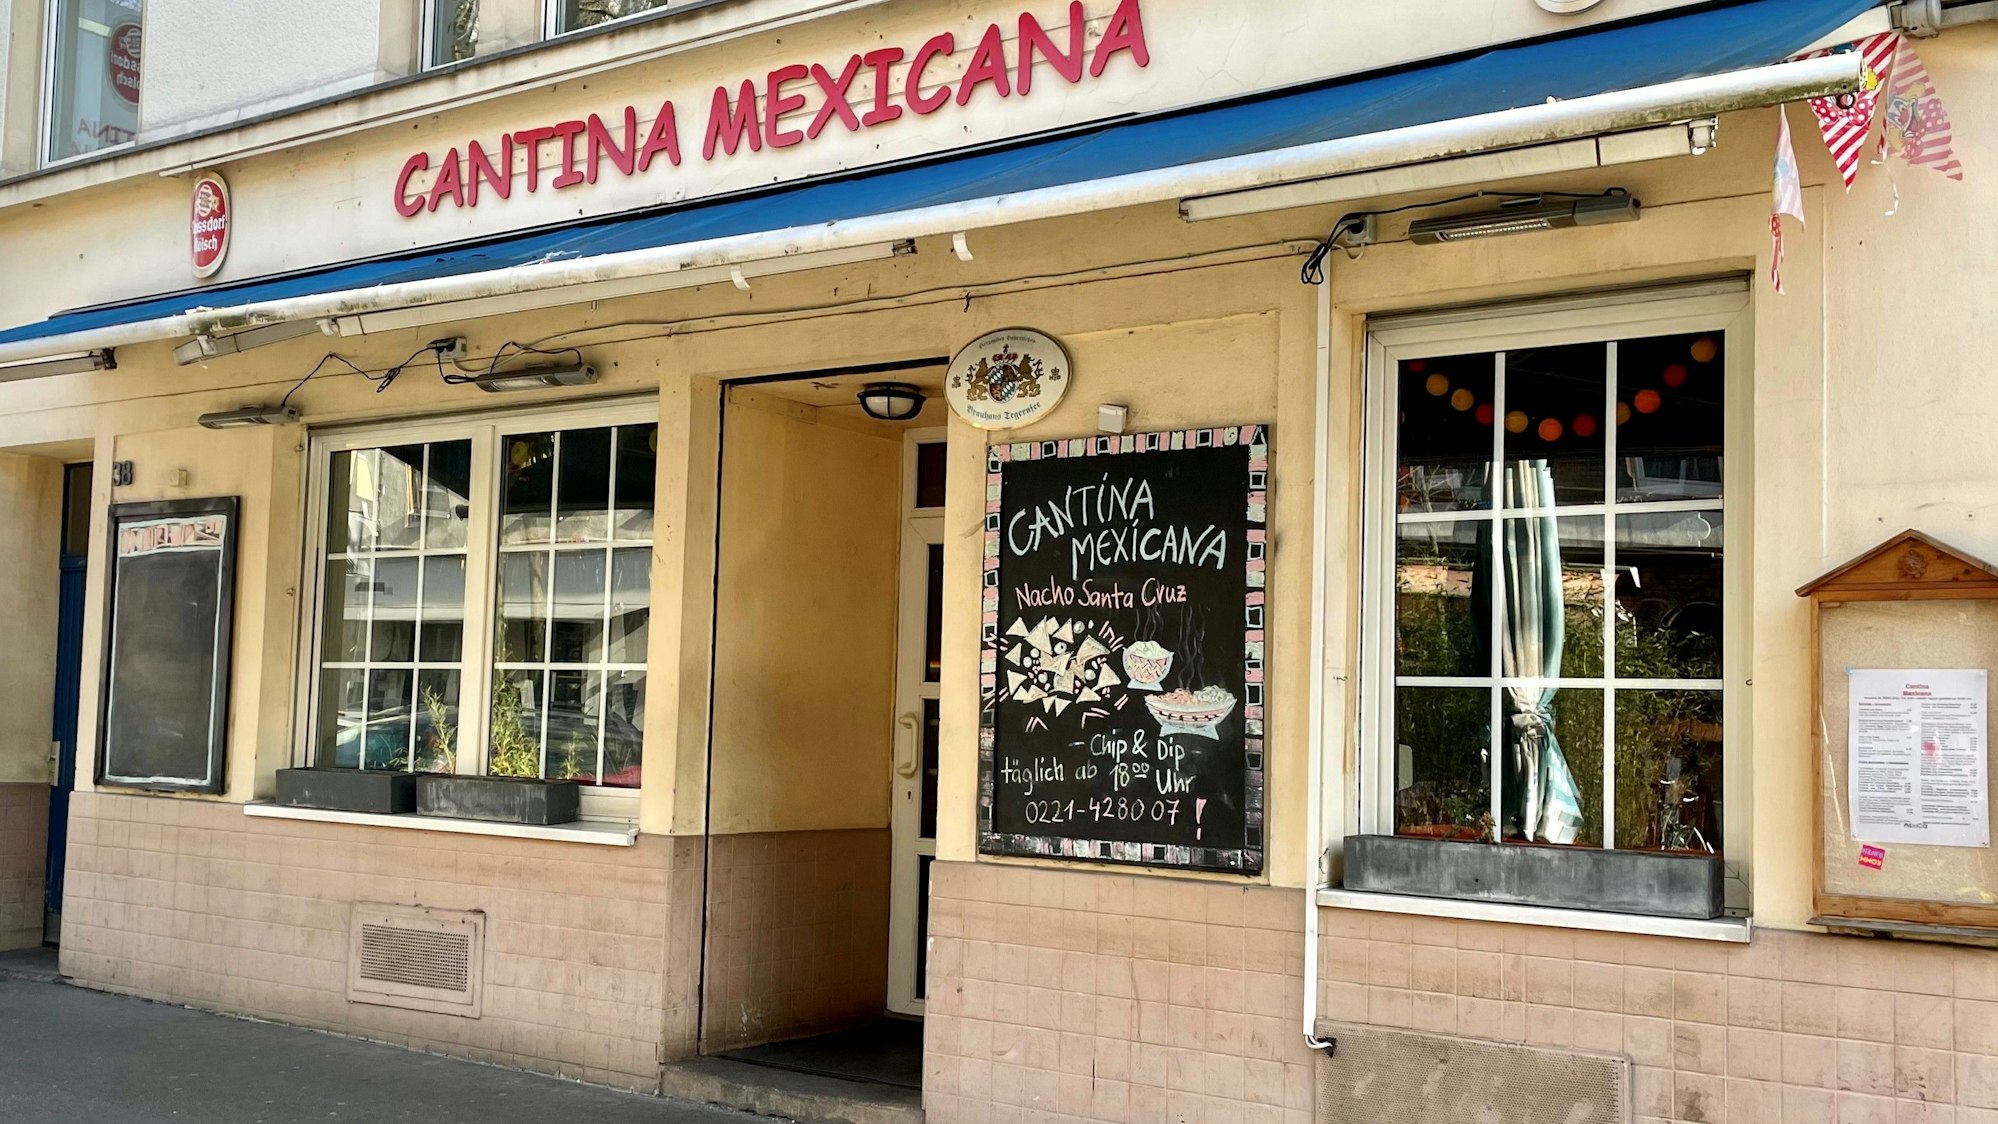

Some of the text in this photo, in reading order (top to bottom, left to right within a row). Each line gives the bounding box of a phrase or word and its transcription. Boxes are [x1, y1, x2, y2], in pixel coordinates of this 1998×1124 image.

[394, 0, 1150, 217] CANTINA MEXICANA
[967, 401, 1041, 421] Brauhaus Tegernsee
[113, 460, 133, 486] 38
[1015, 575, 1187, 610] Nacho Santa Cruz
[1090, 728, 1128, 763] Chip
[1131, 728, 1149, 759] &
[1157, 736, 1186, 772] Dip
[1001, 756, 1065, 796] täglich
[1074, 759, 1098, 781] ab
[1156, 769, 1197, 795] Uhr
